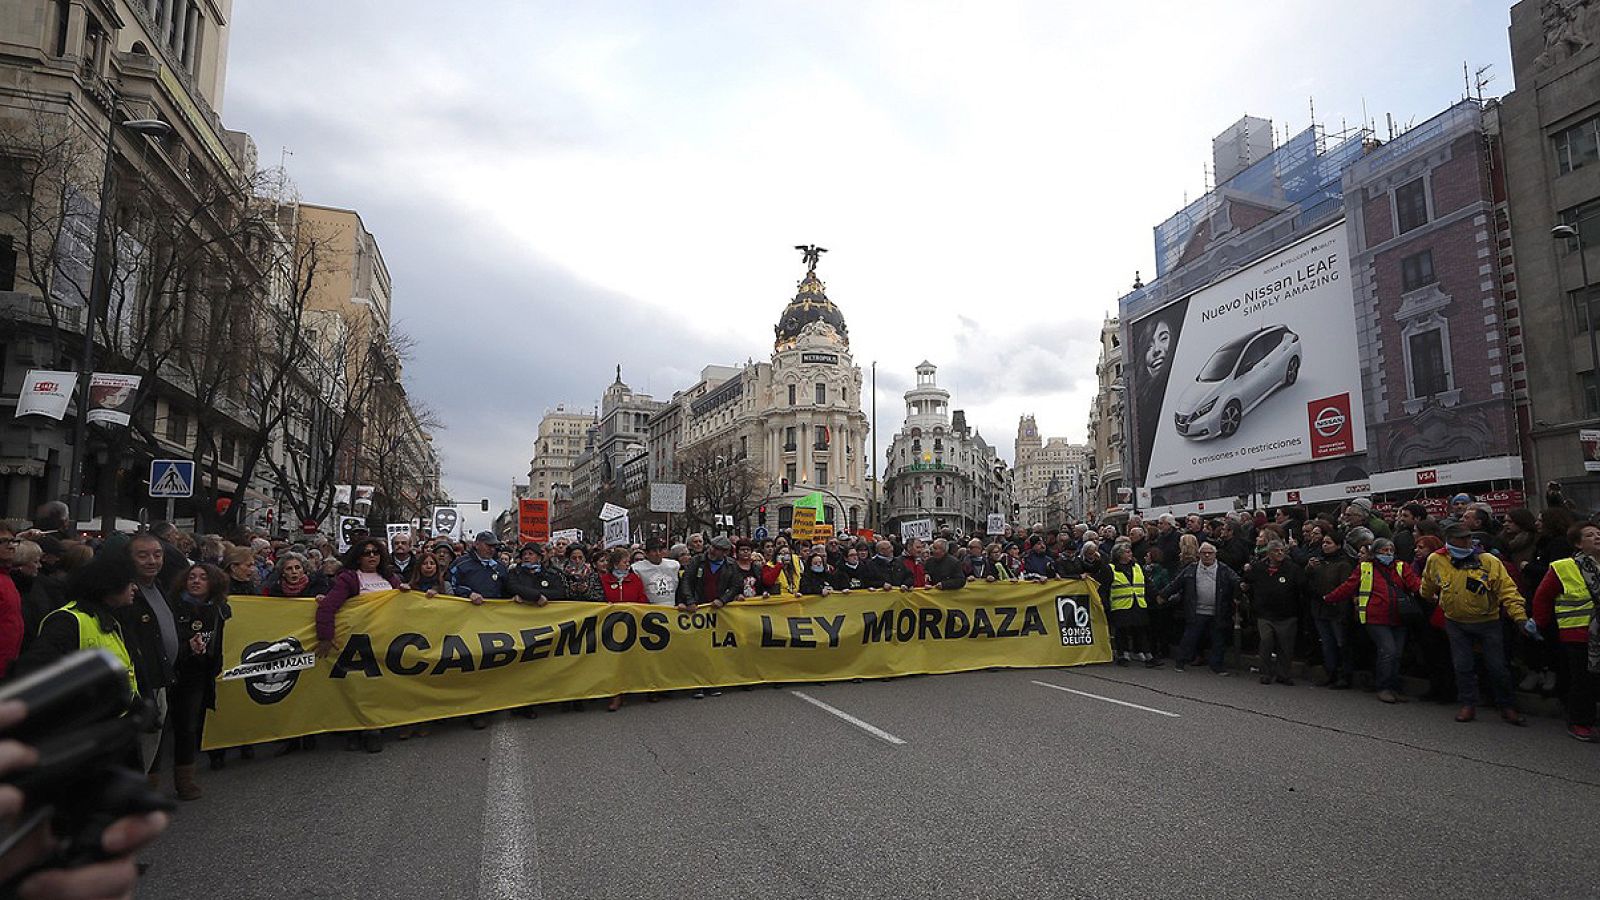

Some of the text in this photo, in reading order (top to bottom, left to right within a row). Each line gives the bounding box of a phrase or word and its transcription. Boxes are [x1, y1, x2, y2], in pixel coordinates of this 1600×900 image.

[1202, 253, 1337, 322] Nuevo Nissan LEAF
[1243, 270, 1339, 316] SIMPLY AMAZING
[1316, 416, 1343, 427] NISSAN
[1198, 451, 1234, 464] emisiones
[1240, 447, 1246, 455] 0
[1247, 437, 1302, 453] restricciones
[329, 605, 1048, 678] ACABEMOS CON LA LEY MORDAZA
[1062, 636, 1092, 644] DELITO
